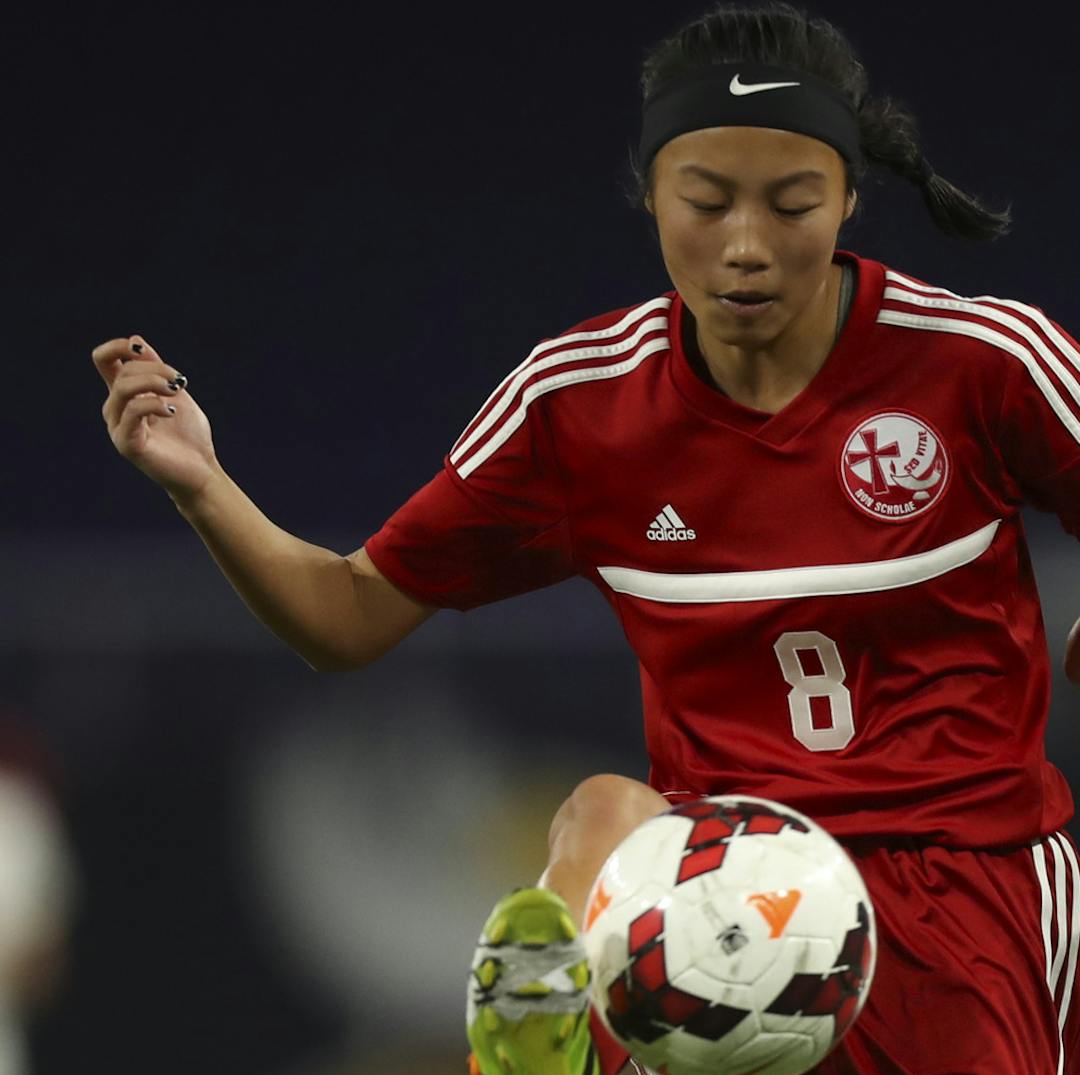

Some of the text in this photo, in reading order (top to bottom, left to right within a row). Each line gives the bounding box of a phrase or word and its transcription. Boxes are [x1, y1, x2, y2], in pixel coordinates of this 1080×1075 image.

[854, 488, 917, 515] NON SCHOLAE
[646, 526, 697, 541] adidas
[773, 630, 856, 752] 8
